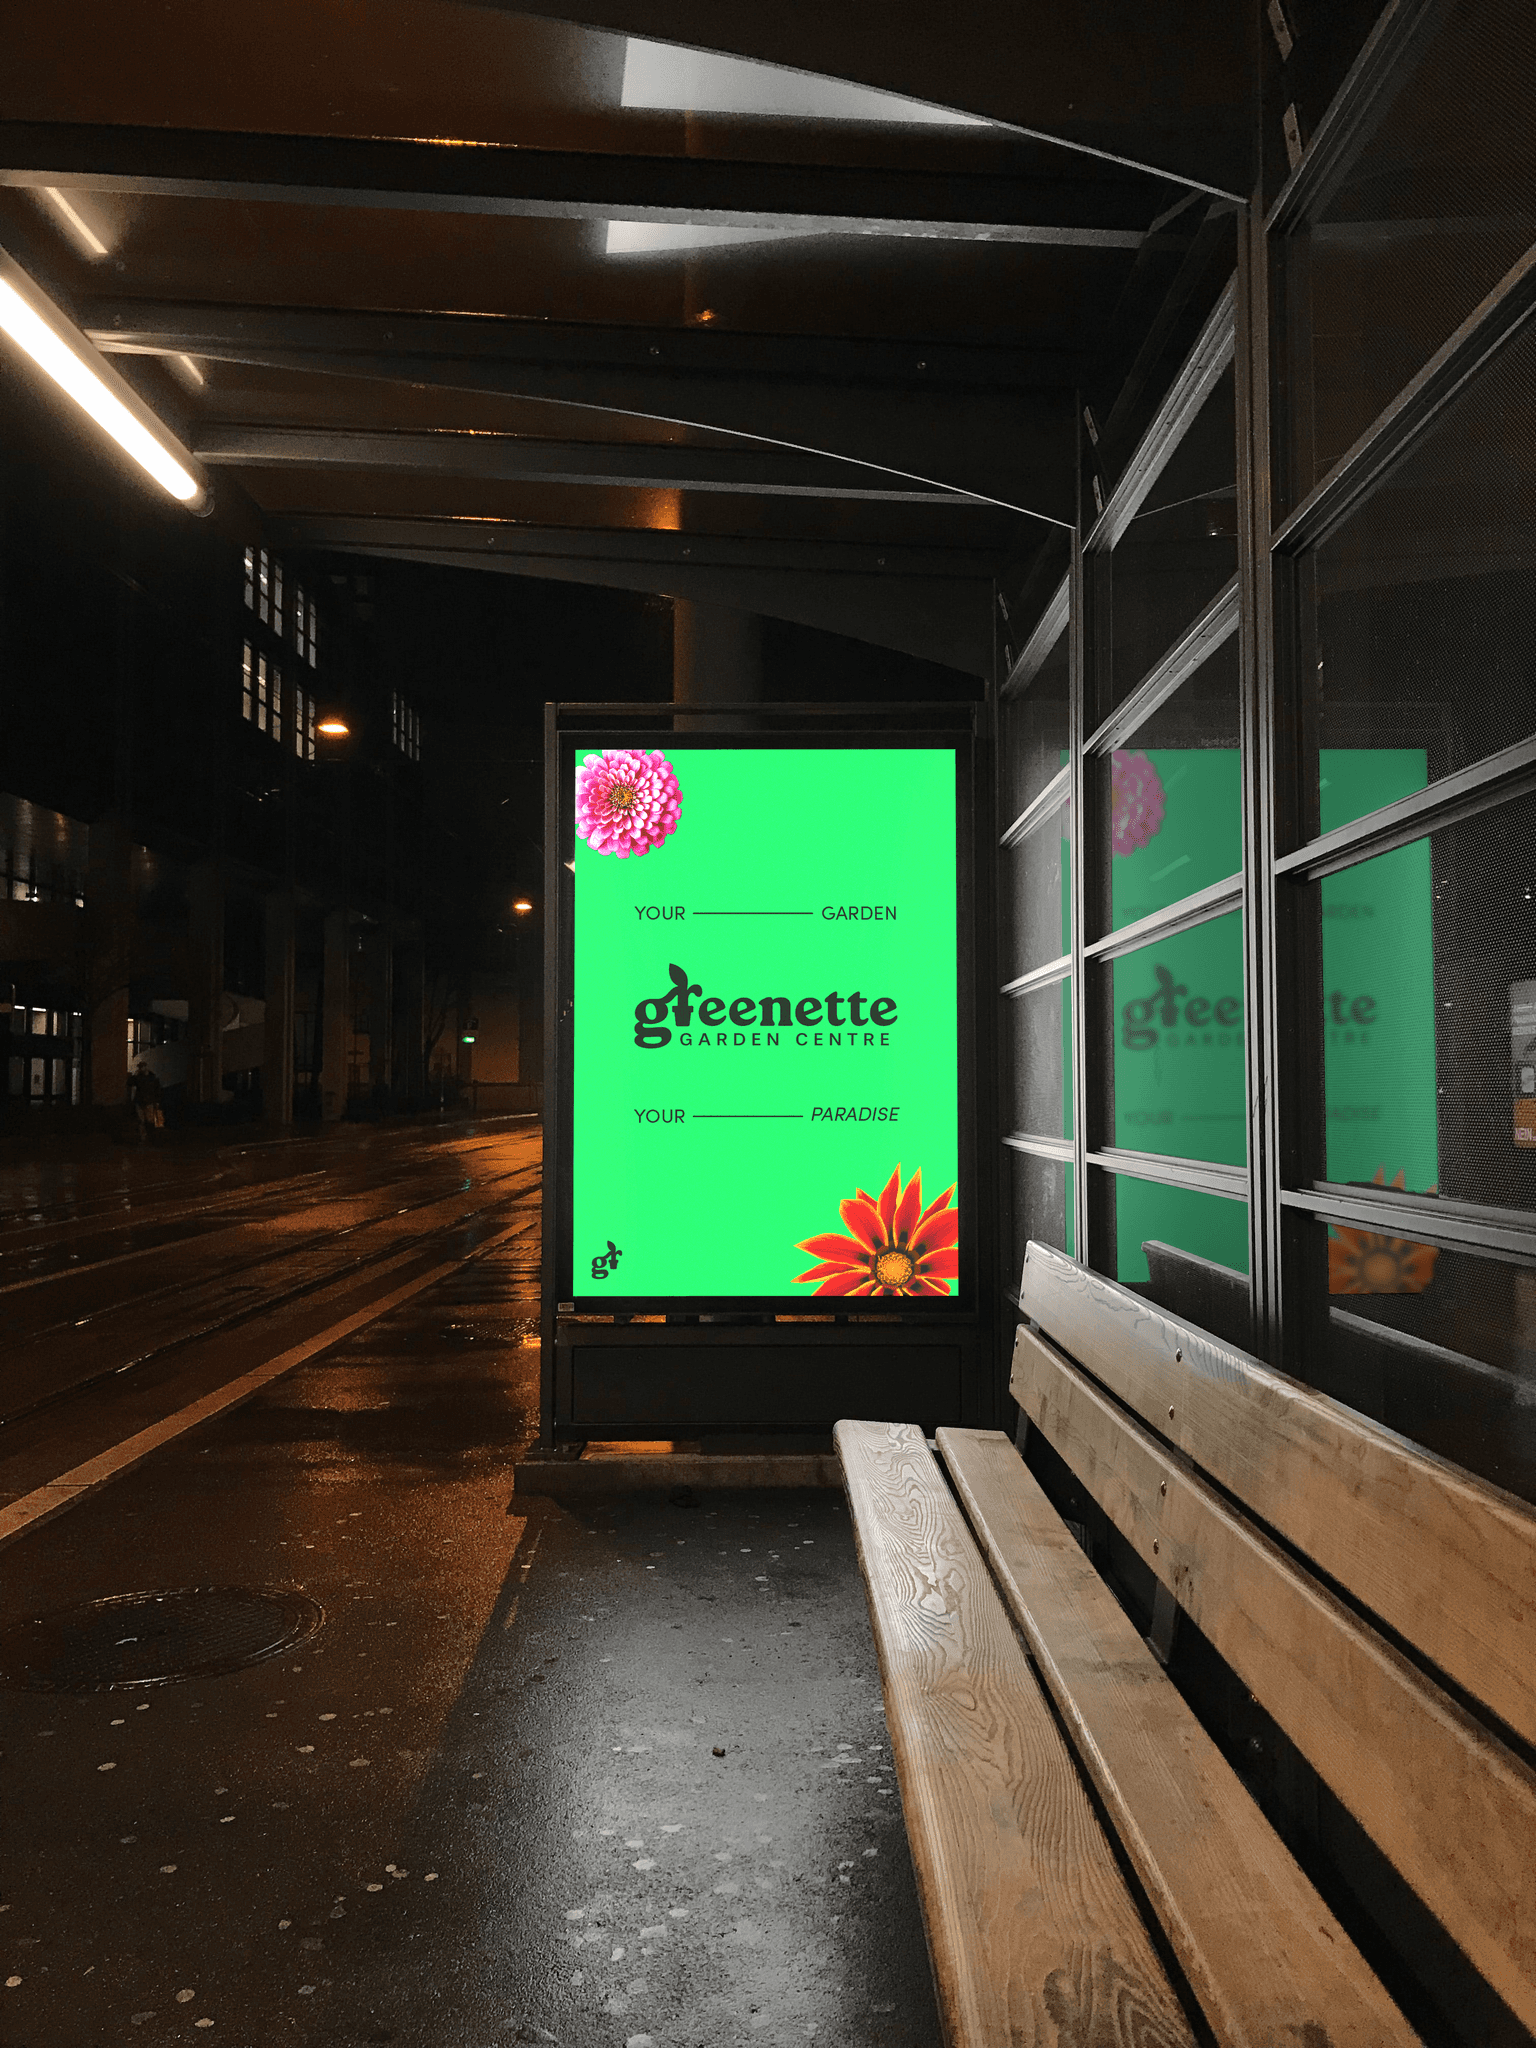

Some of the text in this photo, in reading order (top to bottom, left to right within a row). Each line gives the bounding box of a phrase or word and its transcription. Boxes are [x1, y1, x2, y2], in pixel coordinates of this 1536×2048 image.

[634, 905, 898, 921] YOUR GARDEN
[634, 962, 898, 1049] greenette
[679, 1032, 890, 1046] GARDEN CENTRE
[634, 1106, 900, 1124] YOUR PARADISE
